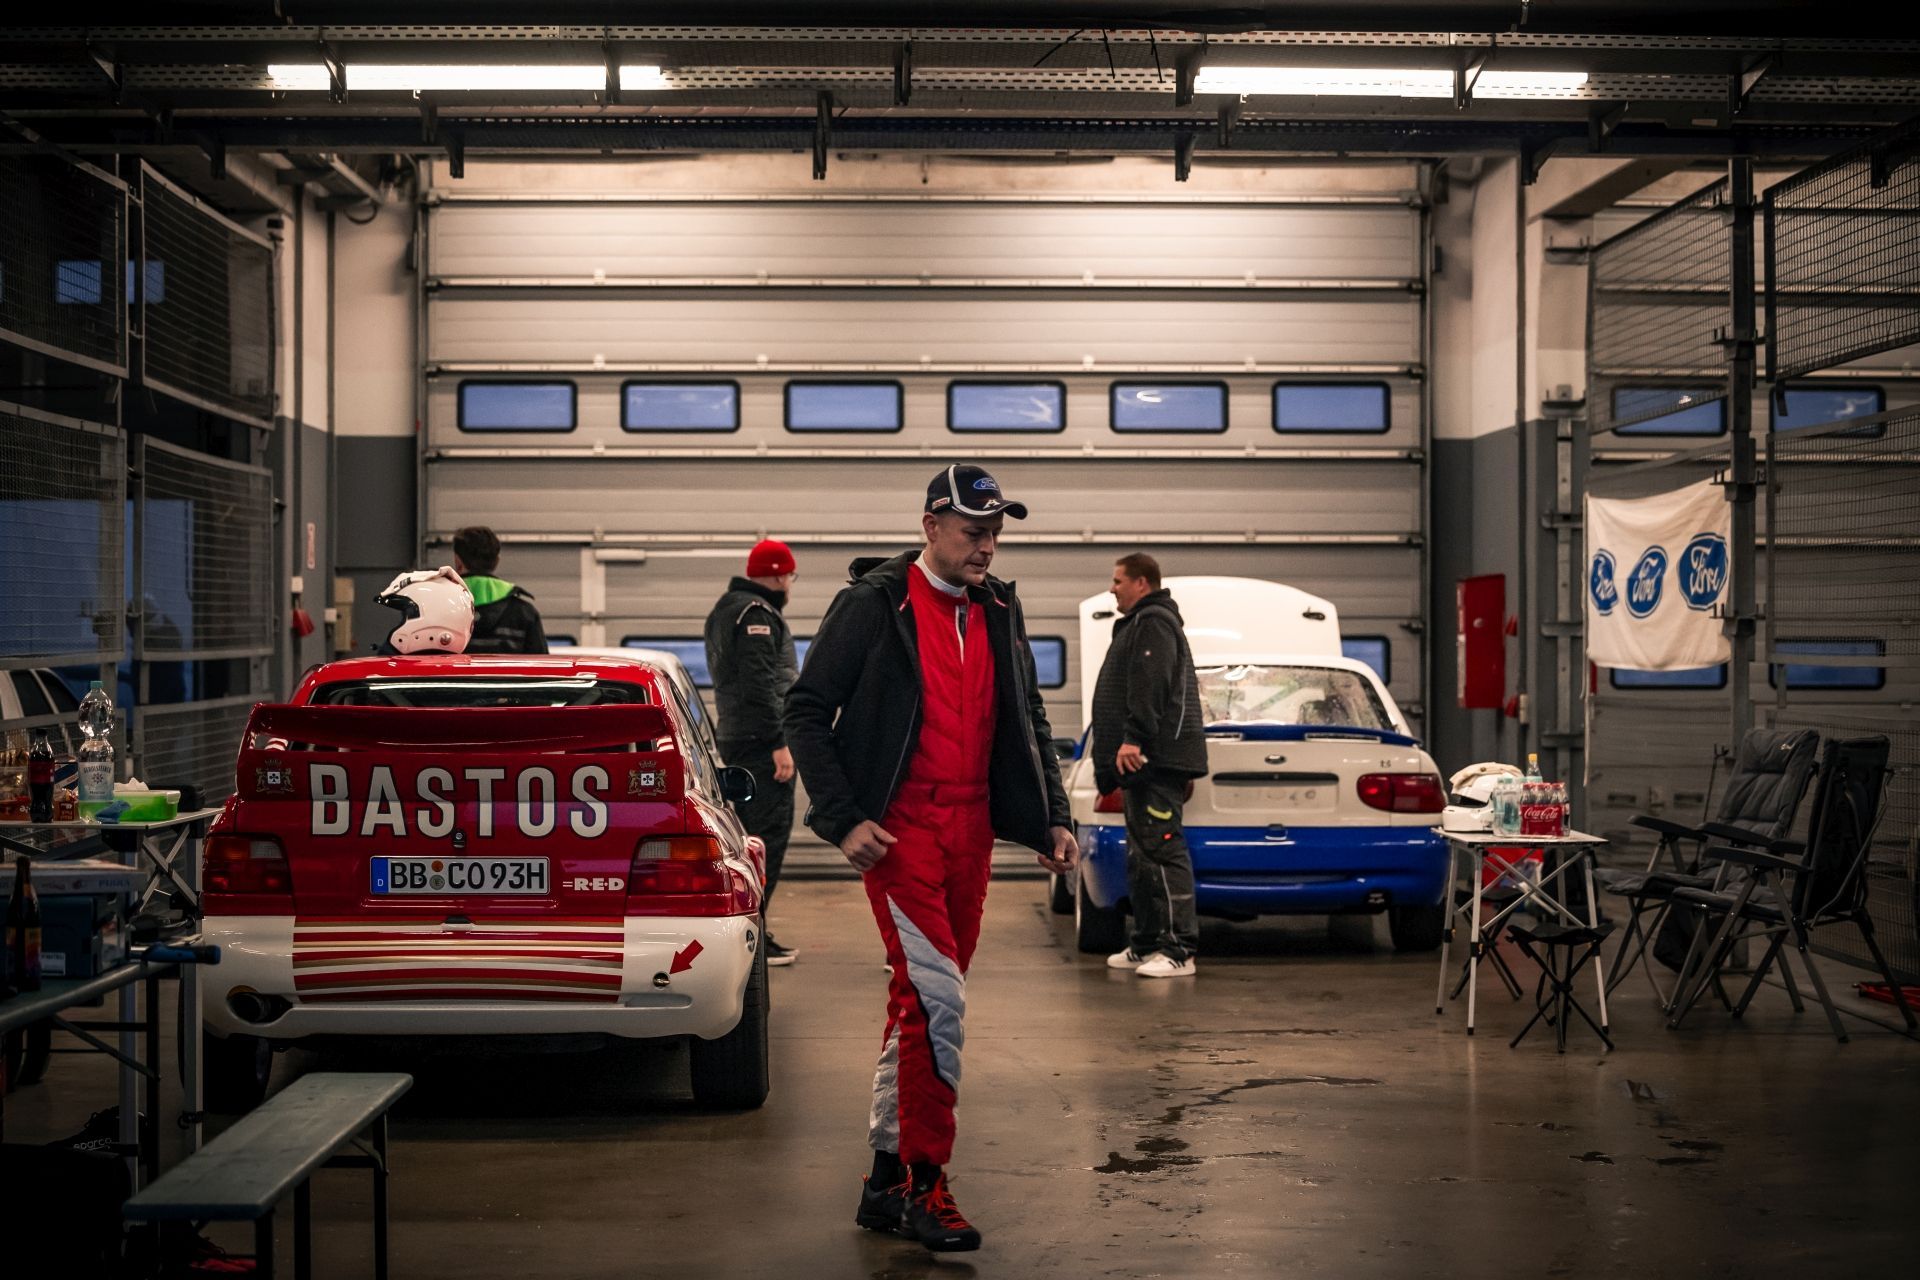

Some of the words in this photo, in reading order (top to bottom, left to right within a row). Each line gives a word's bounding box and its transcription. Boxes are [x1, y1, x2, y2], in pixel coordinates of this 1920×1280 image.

[309, 763, 609, 838] BASTOS
[377, 878, 384, 887] D
[390, 862, 427, 889] BB
